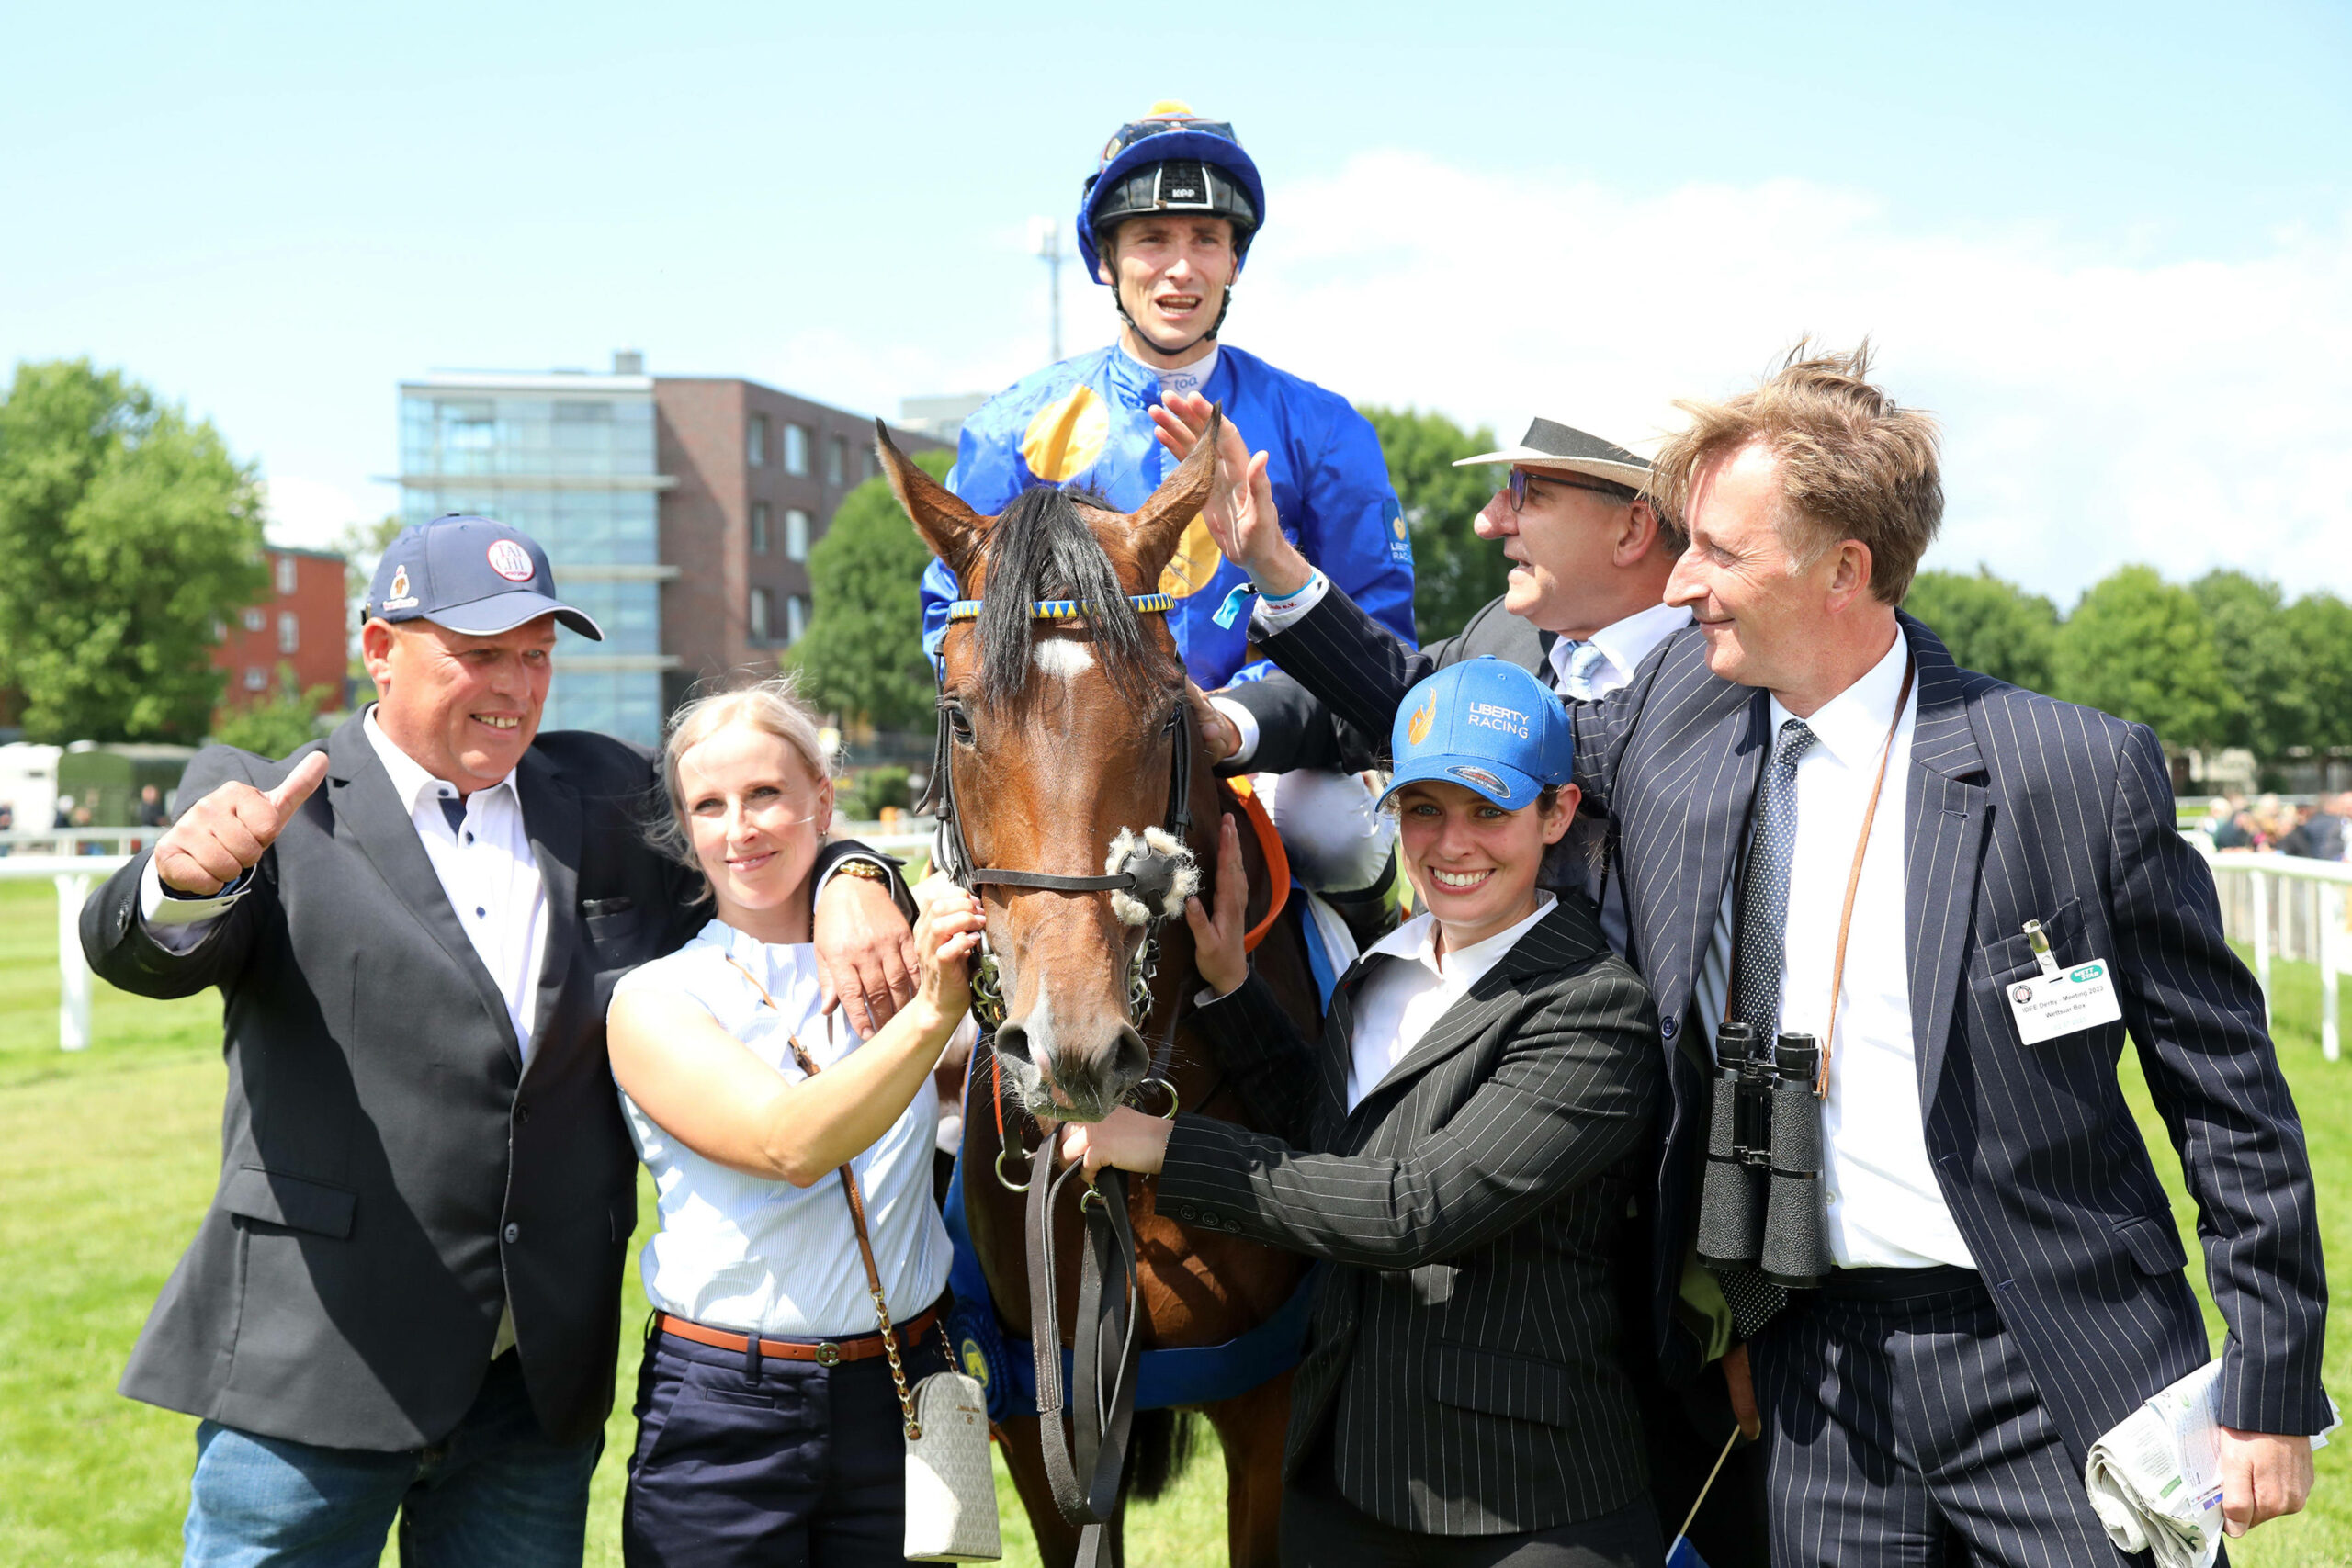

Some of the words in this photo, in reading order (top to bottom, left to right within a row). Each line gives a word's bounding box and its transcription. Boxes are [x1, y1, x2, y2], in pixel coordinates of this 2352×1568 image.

[1470, 701, 1530, 725] LIBERTY
[1468, 715, 1529, 739] RACING
[2022, 1004, 2038, 1013] IDEE
[2039, 999, 2058, 1010] Derby
[2062, 990, 2088, 1002] Meeting
[2088, 986, 2104, 995] 2023
[2045, 1008, 2072, 1019] Wettstar
[2073, 1003, 2086, 1011] Box
